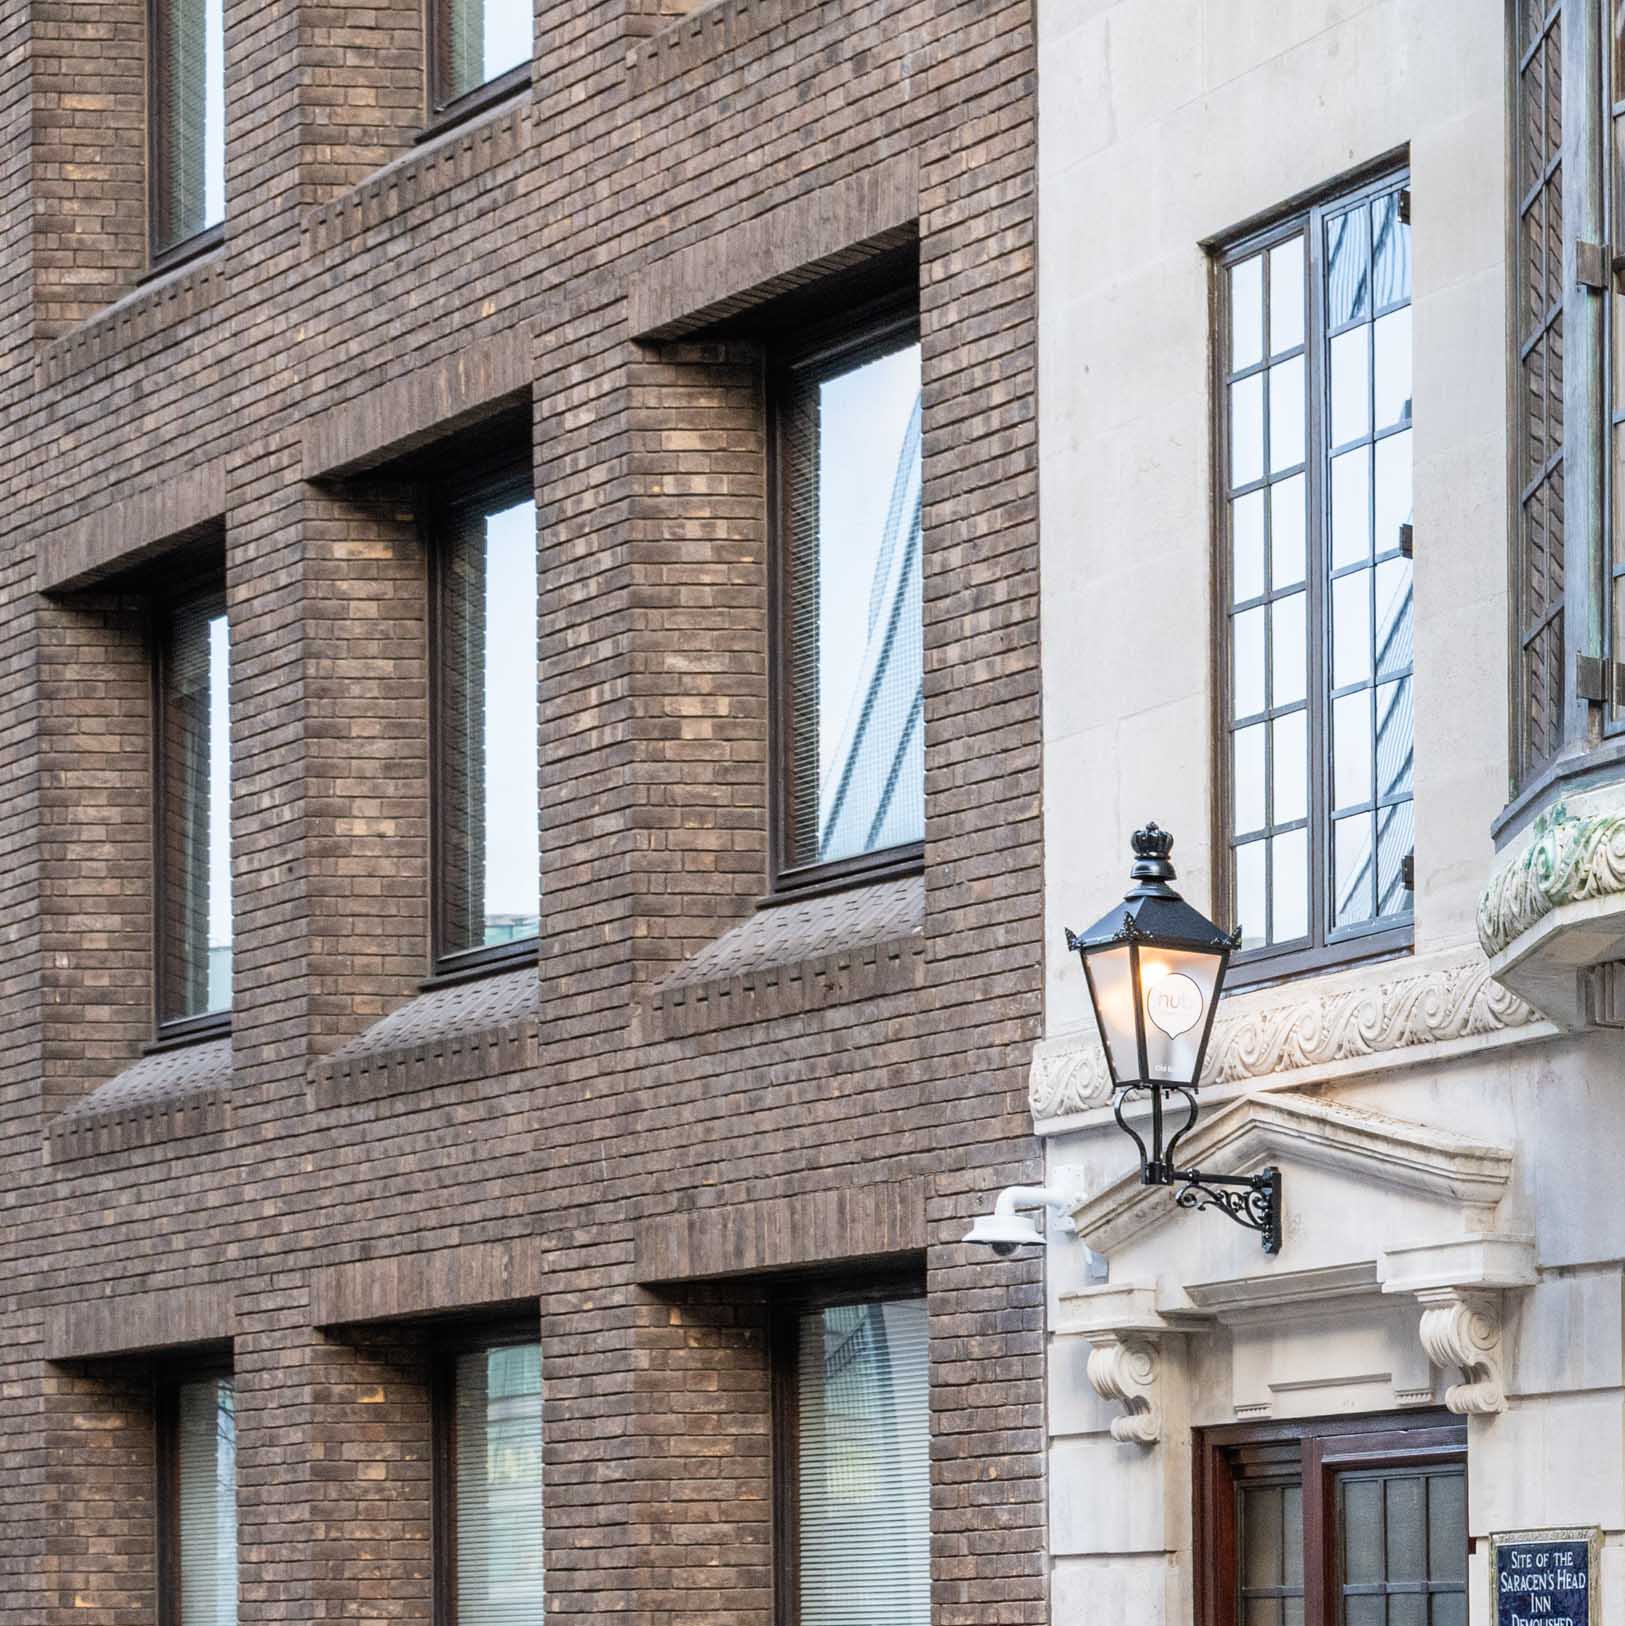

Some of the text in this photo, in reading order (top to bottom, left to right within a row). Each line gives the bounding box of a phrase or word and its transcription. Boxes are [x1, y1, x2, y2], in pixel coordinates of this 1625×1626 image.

[1511, 1551, 1574, 1569] SITE OF THE
[1501, 1569, 1586, 1592] SARACEN'S HEAD
[1531, 1592, 1552, 1613] INN
